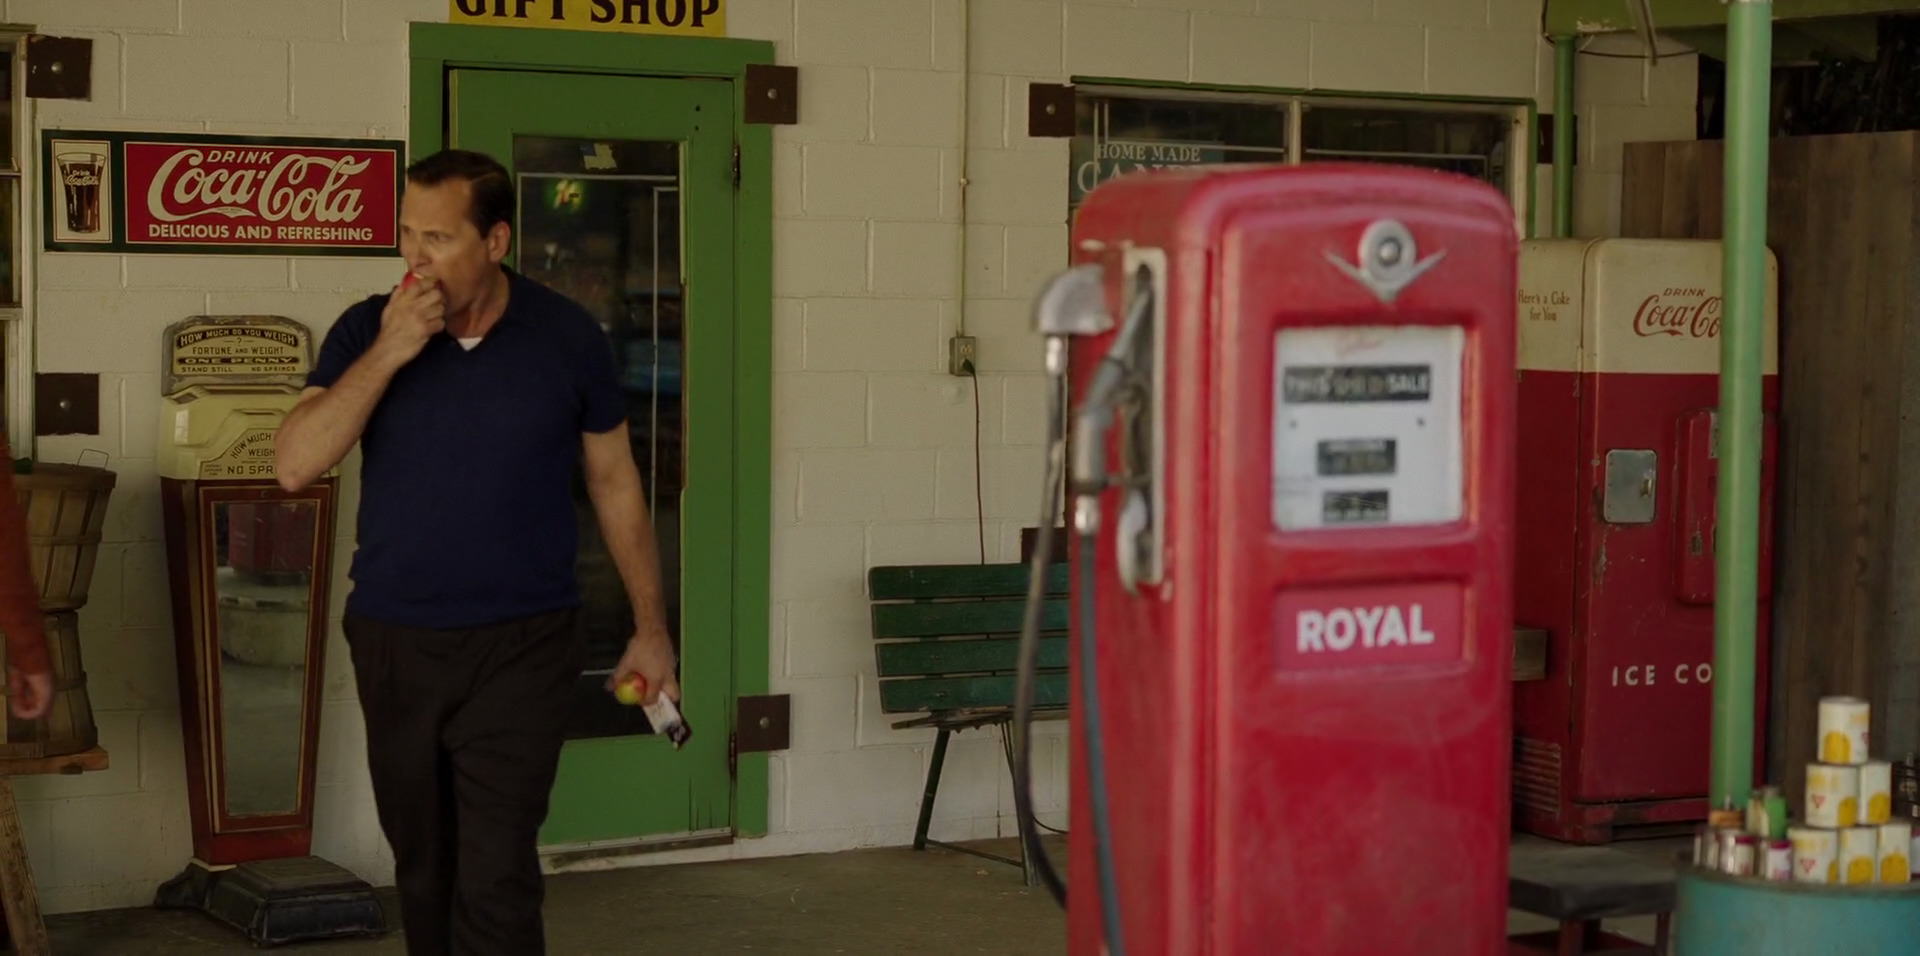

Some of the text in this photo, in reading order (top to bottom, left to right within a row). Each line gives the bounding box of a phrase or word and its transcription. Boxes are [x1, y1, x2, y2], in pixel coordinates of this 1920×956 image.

[590, 0, 719, 27] SHOP
[207, 150, 274, 165] DRINK
[1098, 143, 1200, 161] HOME MADE
[147, 149, 371, 223] Coca-Cola
[149, 223, 373, 241] DELICIOUS AND REFRESHING
[1551, 290, 1570, 305] Coke
[1663, 287, 1706, 297] DRINK
[1542, 307, 1557, 321] You
[1633, 294, 1721, 338] Coca-Co
[180, 331, 203, 346] HOW
[206, 329, 229, 338] MUCH
[246, 329, 262, 337] YOU
[264, 330, 296, 346] WEIGH
[192, 346, 232, 355] FORTUNE
[251, 346, 284, 355] WEIGHT
[1388, 374, 1429, 394] SALE
[231, 432, 271, 459] HOW MUCH
[248, 448, 275, 457] WEIGH
[228, 466, 244, 475] NO
[249, 466, 277, 475] SPR
[1296, 603, 1435, 654] ROYAL
[1612, 662, 1712, 687] ICE CO
